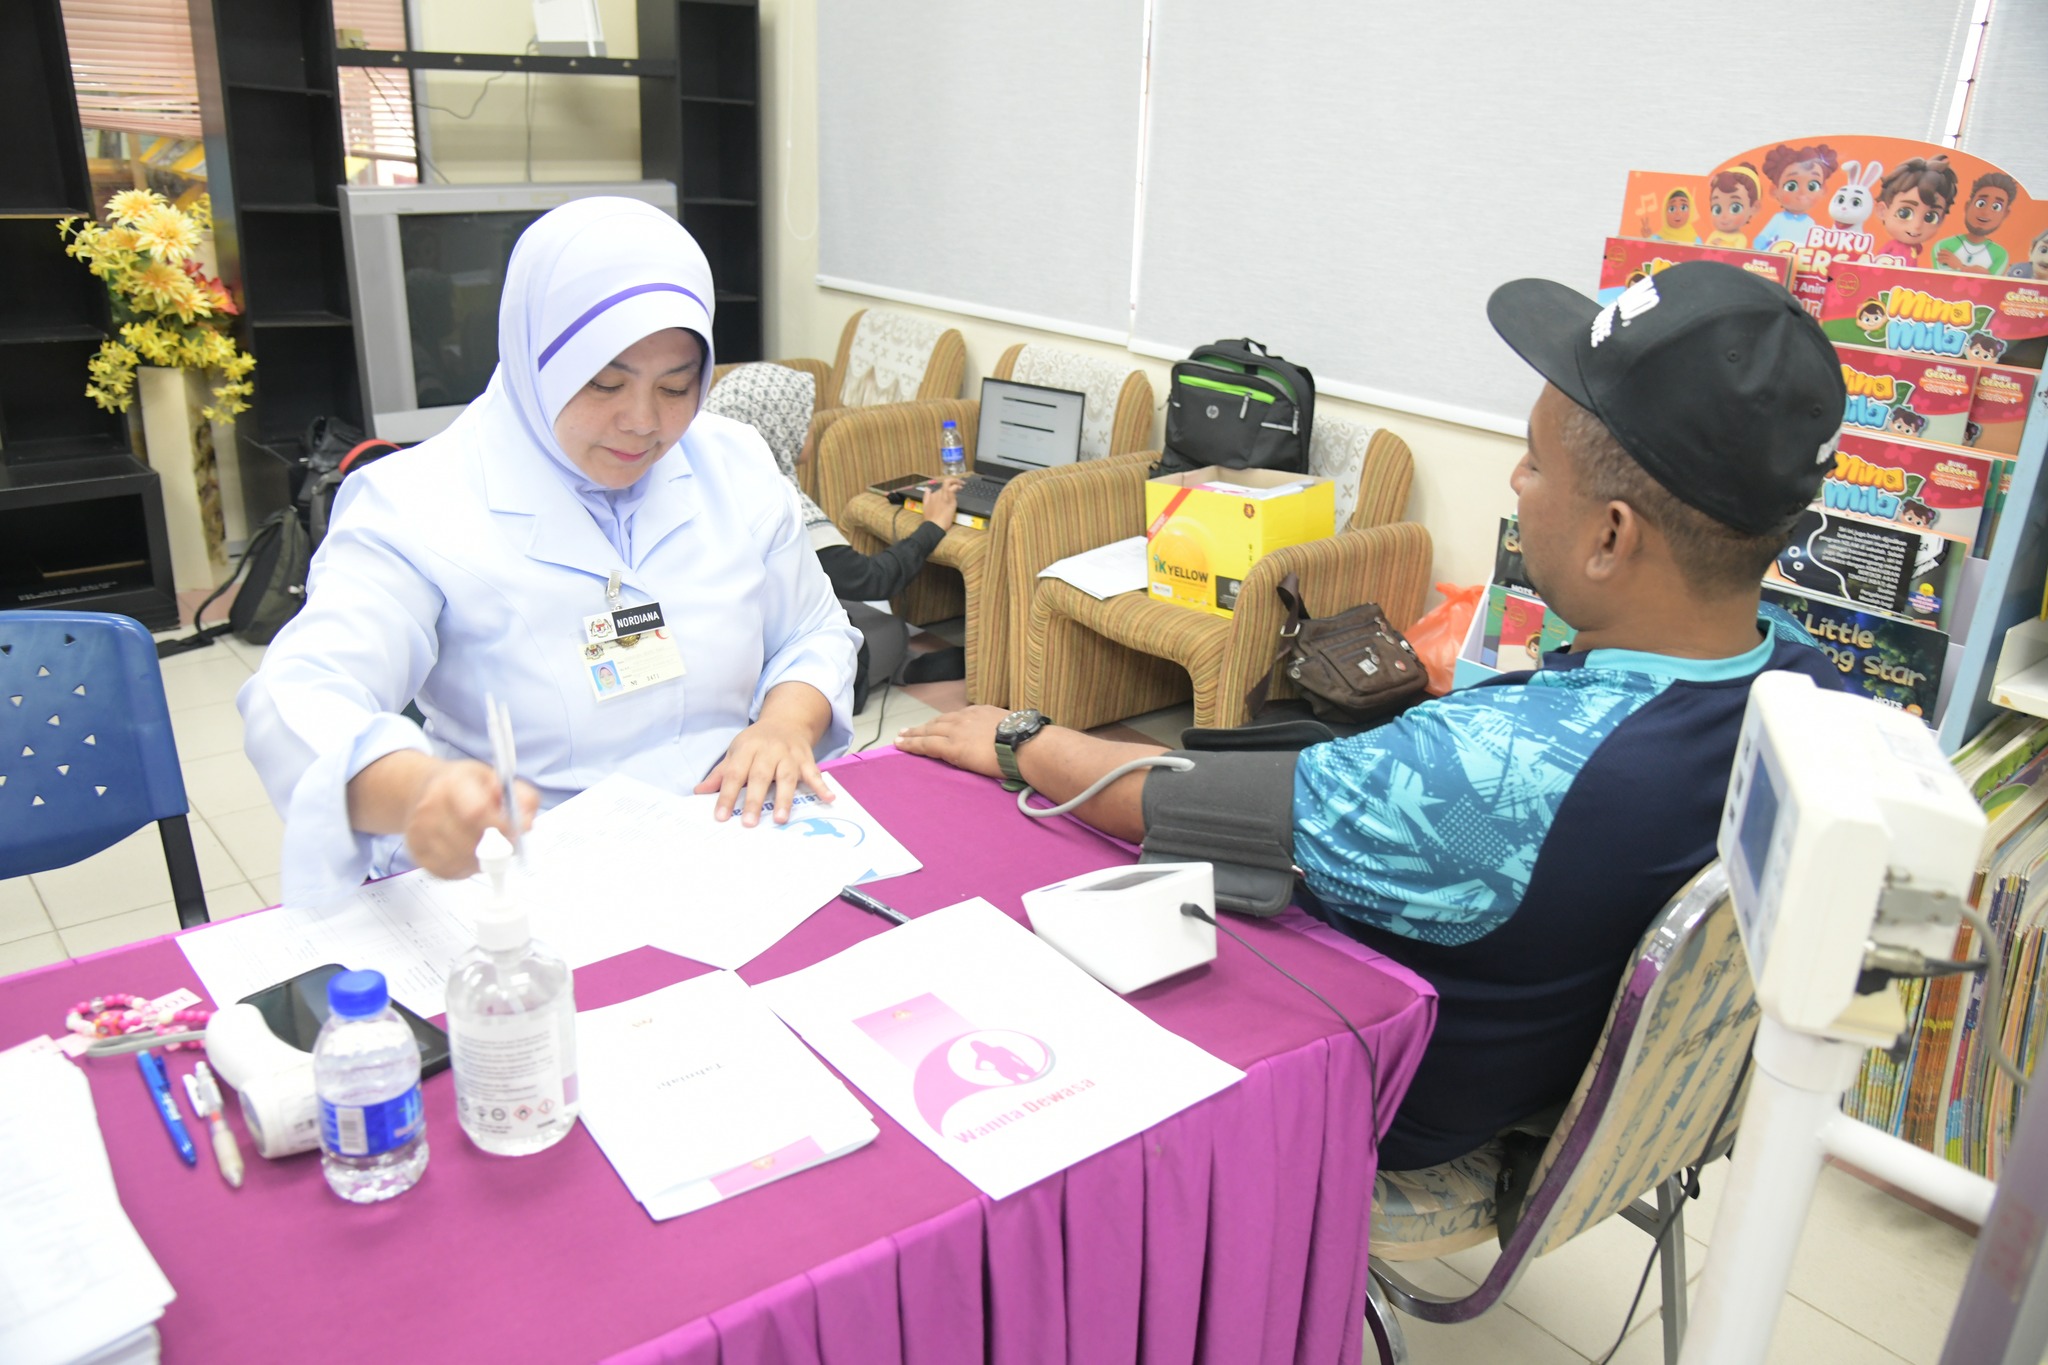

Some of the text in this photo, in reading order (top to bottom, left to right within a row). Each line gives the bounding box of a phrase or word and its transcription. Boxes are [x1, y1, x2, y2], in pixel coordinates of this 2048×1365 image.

[1808, 227, 1871, 254] BUKU
[1888, 287, 1973, 327] Mina
[1887, 321, 1967, 356] Mila
[1843, 395, 1889, 429] ila
[1824, 482, 1899, 520] Mila
[1168, 564, 1209, 583] YELLOW
[616, 610, 660, 629] NORDIANA
[1804, 613, 1875, 649] Little
[1863, 655, 1927, 687] Star
[953, 1078, 1096, 1144] Wanita Dewasa
